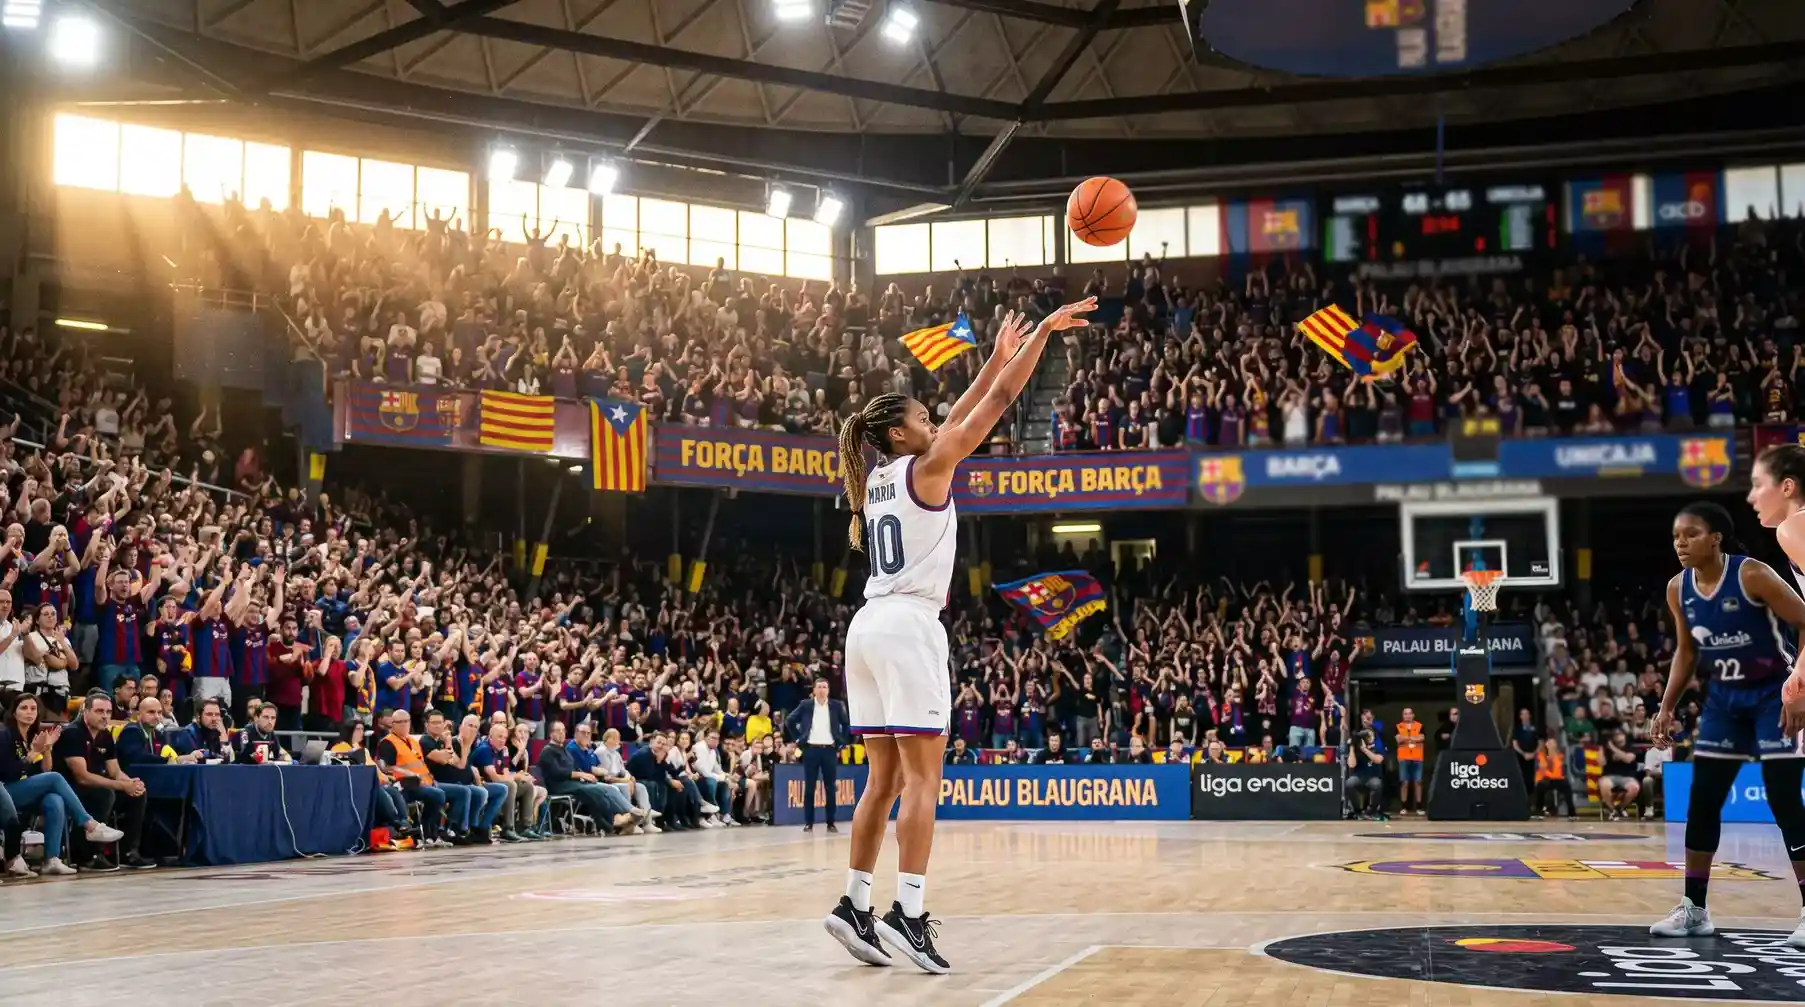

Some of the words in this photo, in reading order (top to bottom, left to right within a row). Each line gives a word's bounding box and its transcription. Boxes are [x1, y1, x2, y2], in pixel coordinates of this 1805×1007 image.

[681, 439, 764, 477] FORÇA
[1266, 454, 1342, 480] BARÇA
[998, 468, 1074, 498] FORÇA
[1081, 464, 1162, 495] BARÇA
[868, 482, 896, 505] MARIA
[868, 514, 905, 577] 10
[1383, 639, 1430, 653] PALAU
[1710, 630, 1750, 646] Unicaja
[1714, 658, 1745, 681] 22
[1450, 761, 1480, 778] liga
[938, 778, 1010, 806] PALAU
[1017, 778, 1159, 806] BLAUGRANA
[1200, 773, 1242, 797] liga
[1247, 773, 1333, 793] endesa
[1450, 776, 1508, 789] endesa
